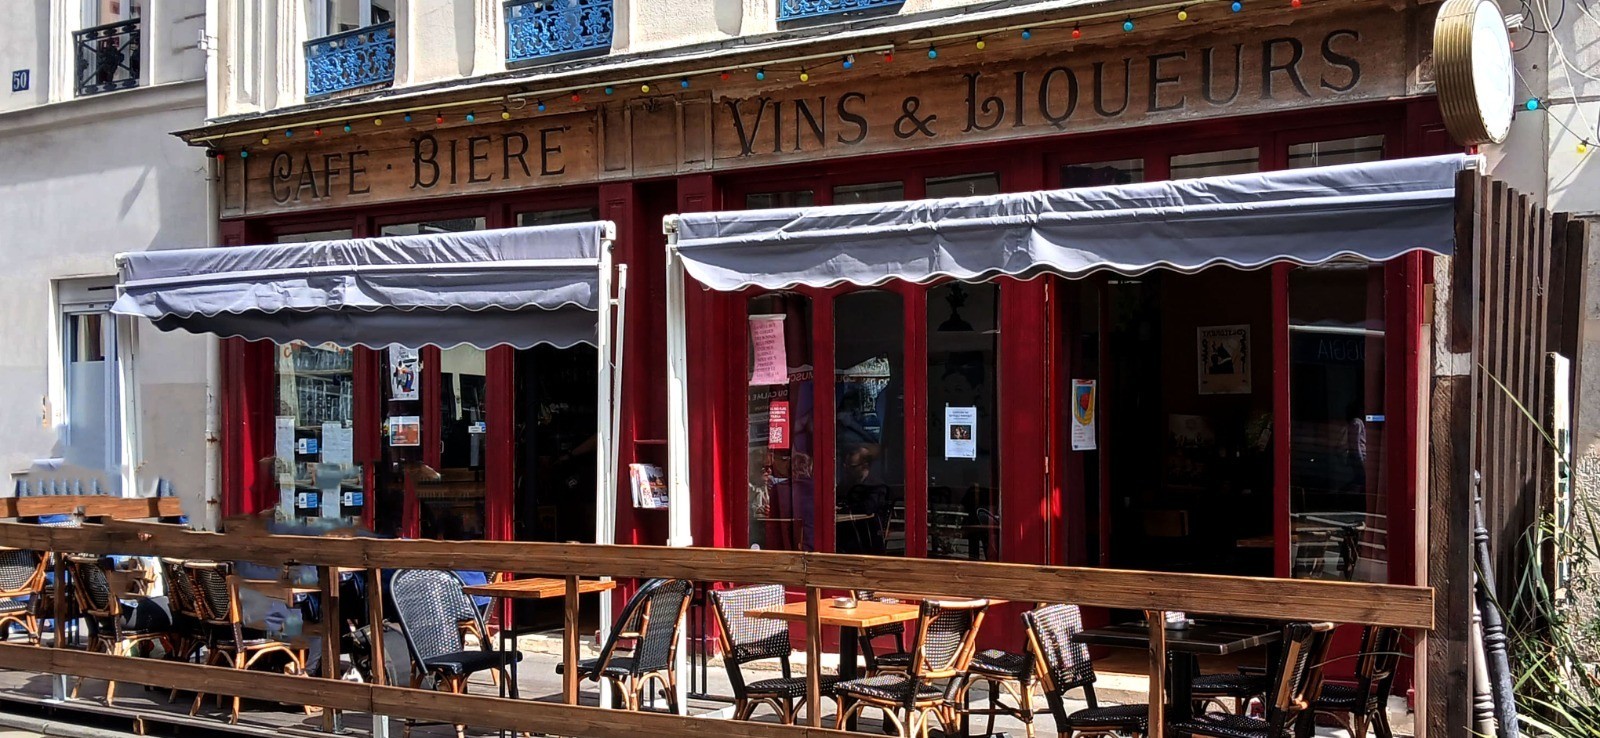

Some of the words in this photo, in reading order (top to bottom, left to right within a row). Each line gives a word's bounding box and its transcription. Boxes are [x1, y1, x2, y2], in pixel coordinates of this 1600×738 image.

[13, 71, 27, 90] 50
[724, 92, 869, 157] VINS
[894, 96, 938, 139] &
[961, 29, 1362, 133] LIQUEURS
[269, 145, 371, 204] CAFÉ
[409, 126, 570, 190] BIERE
